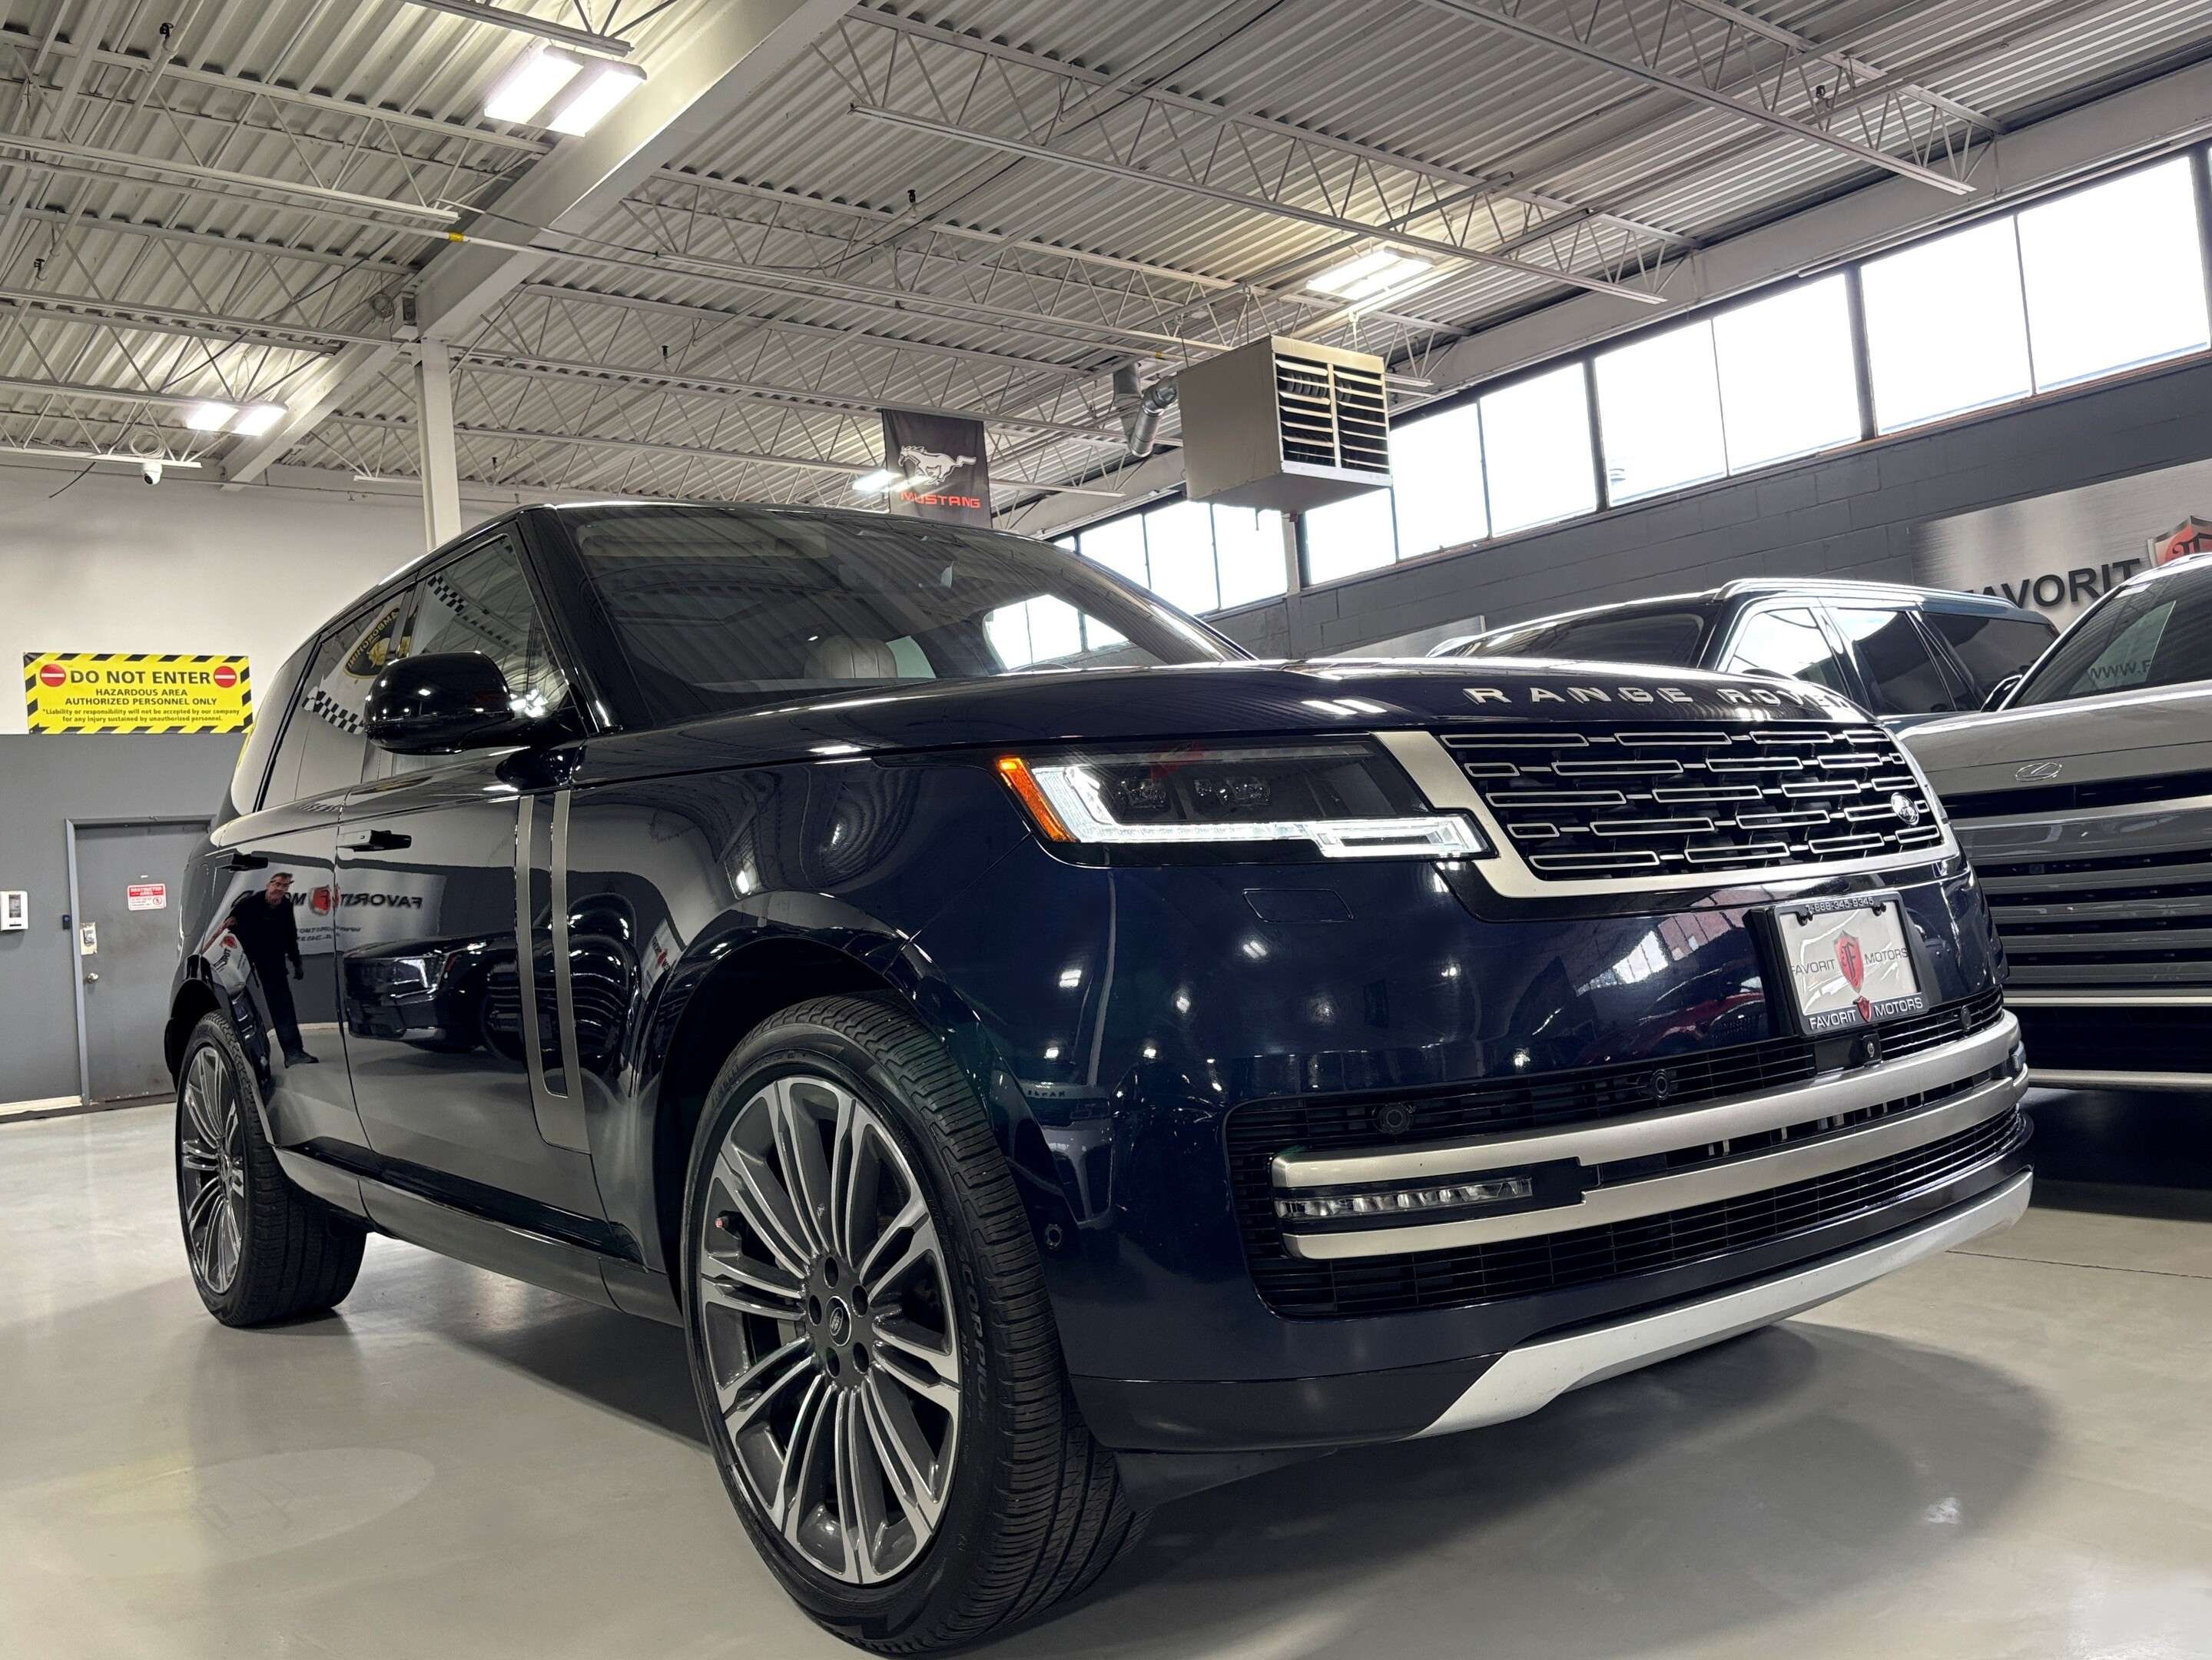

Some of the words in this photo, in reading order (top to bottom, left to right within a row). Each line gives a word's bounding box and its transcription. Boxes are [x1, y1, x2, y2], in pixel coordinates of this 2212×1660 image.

[900, 492, 981, 509] MUSTANG
[1963, 558, 2141, 609] VORIT
[70, 670, 100, 684] DO
[106, 671, 146, 684] NOT
[152, 671, 211, 685] ENTER
[1462, 687, 1694, 705] RANGE
[1806, 897, 1874, 915] 1-888-345-9345
[1864, 947, 1909, 964] MOTORS
[1809, 1010, 1856, 1030] FAVORIT
[1874, 998, 1923, 1017] MOTORS
